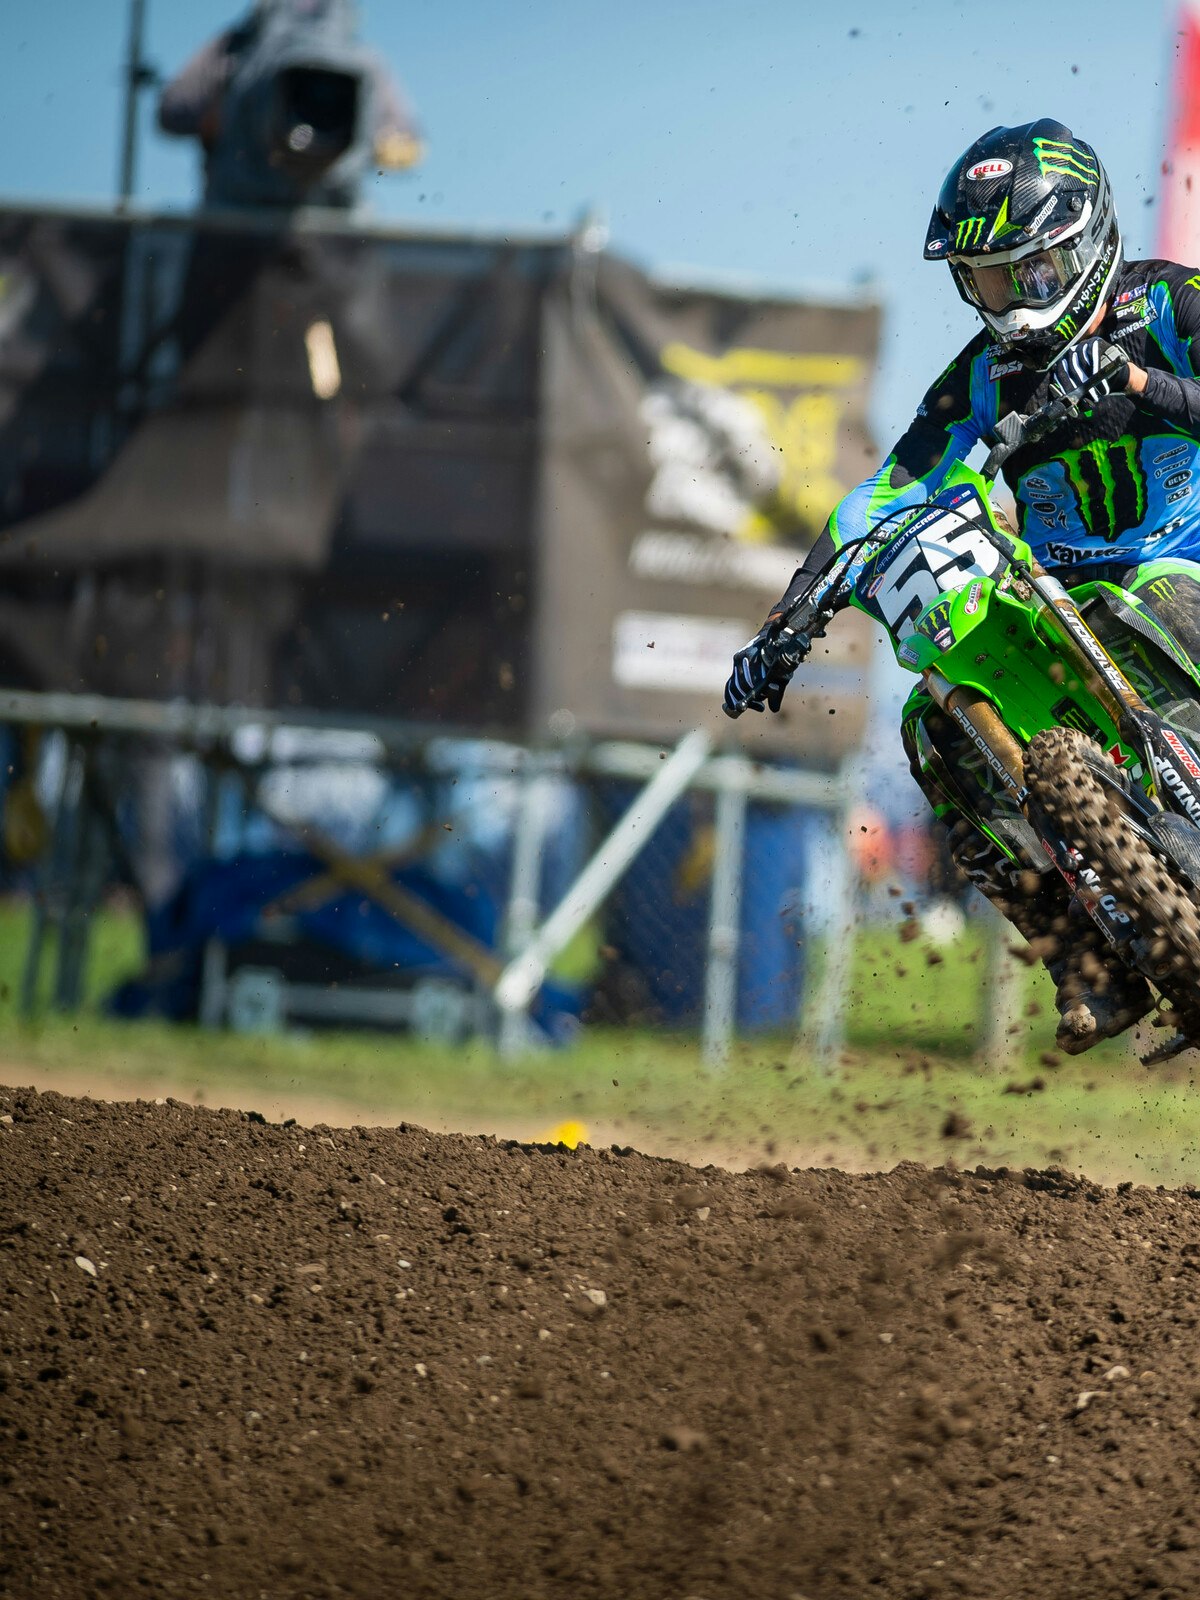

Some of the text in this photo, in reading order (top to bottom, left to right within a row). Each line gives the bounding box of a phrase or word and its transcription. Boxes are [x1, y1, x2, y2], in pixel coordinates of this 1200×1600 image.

[973, 164, 1004, 177] BELL
[1110, 306, 1158, 342] Kawasaki
[1168, 473, 1187, 486] BELL
[874, 498, 999, 642] 55
[1059, 608, 1128, 690] PRO CIRCUIT
[952, 706, 1017, 788] PRO CIRCUIT
